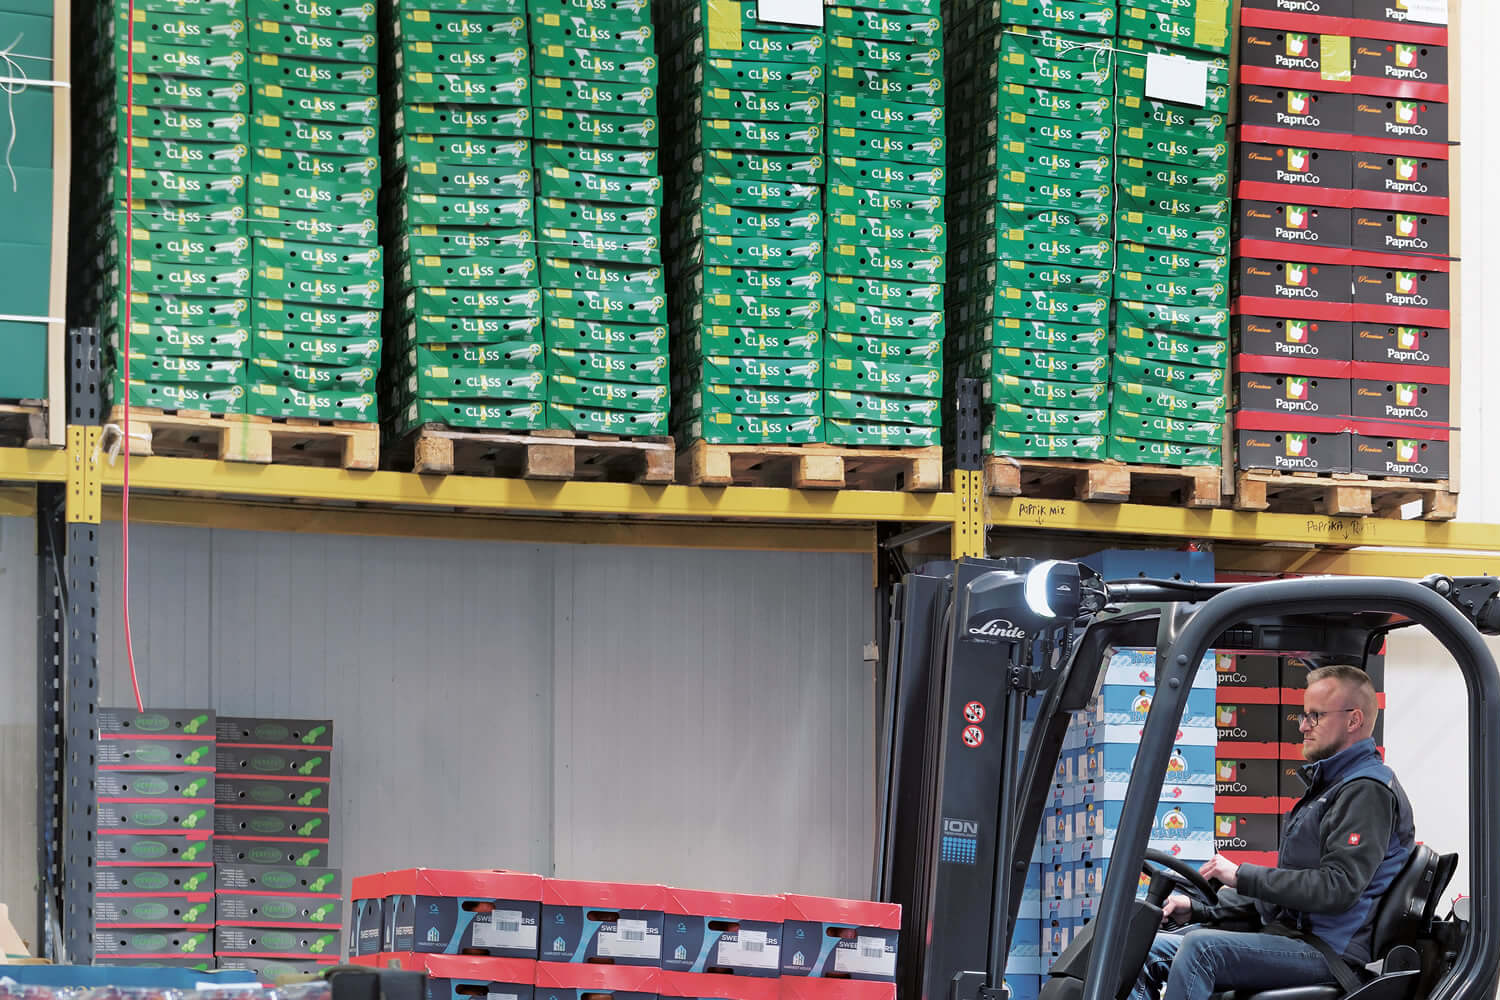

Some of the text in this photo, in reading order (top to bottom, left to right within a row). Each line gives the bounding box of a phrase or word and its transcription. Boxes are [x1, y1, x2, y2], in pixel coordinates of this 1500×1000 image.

[296, 4, 331, 16] CLASS
[1043, 7, 1074, 19] CLASS
[164, 23, 200, 35] CLASS
[448, 21, 482, 33] CLASS
[868, 19, 900, 31] CLASS
[576, 27, 610, 39] CLASS
[296, 35, 332, 47] CLASS
[749, 40, 782, 52] CLASS
[164, 53, 200, 65] CLASS
[450, 52, 485, 64] CLASS
[869, 49, 900, 61] CLASS
[581, 58, 614, 70] CLASS
[1275, 55, 1319, 68] PapriCo
[296, 68, 331, 80] CLASS
[749, 68, 781, 80] CLASS
[1385, 66, 1428, 79] PapriCo
[166, 84, 201, 96] CLASS
[450, 81, 485, 93] CLASS
[869, 79, 901, 91] CLASS
[578, 89, 611, 101] CLASS
[300, 99, 335, 111] CLASS
[746, 98, 779, 110] CLASS
[1040, 97, 1070, 109] CLASS
[166, 116, 202, 128] CLASS
[452, 112, 486, 124] CLASS
[872, 110, 903, 122] CLASS
[1276, 113, 1321, 126] PapriCo
[580, 121, 613, 133] CLASS
[1385, 123, 1428, 136] PapriCo
[297, 128, 332, 140] CLASS
[747, 128, 779, 140] CLASS
[451, 143, 485, 155] CLASS
[871, 139, 902, 151] CLASS
[167, 148, 203, 160] CLASS
[580, 152, 613, 164] CLASS
[299, 160, 333, 172] CLASS
[749, 159, 781, 171] CLASS
[1040, 156, 1070, 168] CLASS
[455, 174, 489, 186] CLASS
[1277, 171, 1320, 184] PapriCo
[164, 178, 200, 190] CLASS
[586, 179, 620, 191] CLASS
[1385, 180, 1428, 193] PapriCo
[748, 185, 780, 197] CLASS
[1040, 186, 1071, 198] CLASS
[455, 202, 489, 214] CLASS
[1160, 201, 1190, 213] CLASS
[582, 210, 615, 222] CLASS
[1039, 213, 1069, 225] CLASS
[747, 217, 780, 229] CLASS
[1158, 226, 1187, 238] CLASS
[1275, 228, 1319, 241] PapriCo
[168, 242, 204, 254] CLASS
[455, 236, 489, 248] CLASS
[1040, 242, 1070, 254] CLASS
[1385, 236, 1429, 249] PapriCo
[749, 245, 781, 257] CLASS
[871, 258, 903, 270] CLASS
[1160, 255, 1189, 267] CLASS
[169, 271, 205, 283] CLASS
[748, 274, 781, 286] CLASS
[300, 282, 336, 294] CLASS
[869, 284, 901, 296] CLASS
[1156, 283, 1186, 295] CLASS
[1275, 285, 1319, 298] PapriCo
[1036, 299, 1068, 311] CLASS
[1385, 293, 1429, 306] PapriCo
[167, 302, 203, 314] CLASS
[301, 312, 336, 324] CLASS
[872, 314, 903, 326] CLASS
[1159, 310, 1189, 322] CLASS
[592, 330, 624, 342] CLASS
[1035, 329, 1066, 341] CLASS
[301, 341, 336, 353] CLASS
[1158, 341, 1188, 353] CLASS
[1275, 342, 1319, 355] PapriCo
[1387, 349, 1430, 362] PapriCo
[164, 358, 200, 370] CLASS
[592, 357, 625, 369] CLASS
[746, 363, 779, 375] CLASS
[1036, 358, 1066, 370] CLASS
[868, 370, 900, 382] CLASS
[1155, 367, 1184, 379] CLASS
[467, 376, 501, 388] CLASS
[1035, 385, 1065, 397] CLASS
[294, 395, 330, 407] CLASS
[867, 399, 899, 411] CLASS
[1157, 395, 1187, 407] CLASS
[1275, 398, 1319, 411] PapriCo
[466, 407, 500, 419] CLASS
[1385, 405, 1429, 418] PapriCo
[591, 413, 624, 425] CLASS
[1154, 418, 1184, 430] CLASS
[1151, 444, 1181, 456] CLASS
[1275, 455, 1319, 468] PapriCo
[1386, 461, 1429, 474] PapriCo
[968, 618, 1025, 640] Linde
[1218, 673, 1247, 684] priCo
[1218, 728, 1248, 739] priCo
[944, 820, 977, 833] ION
